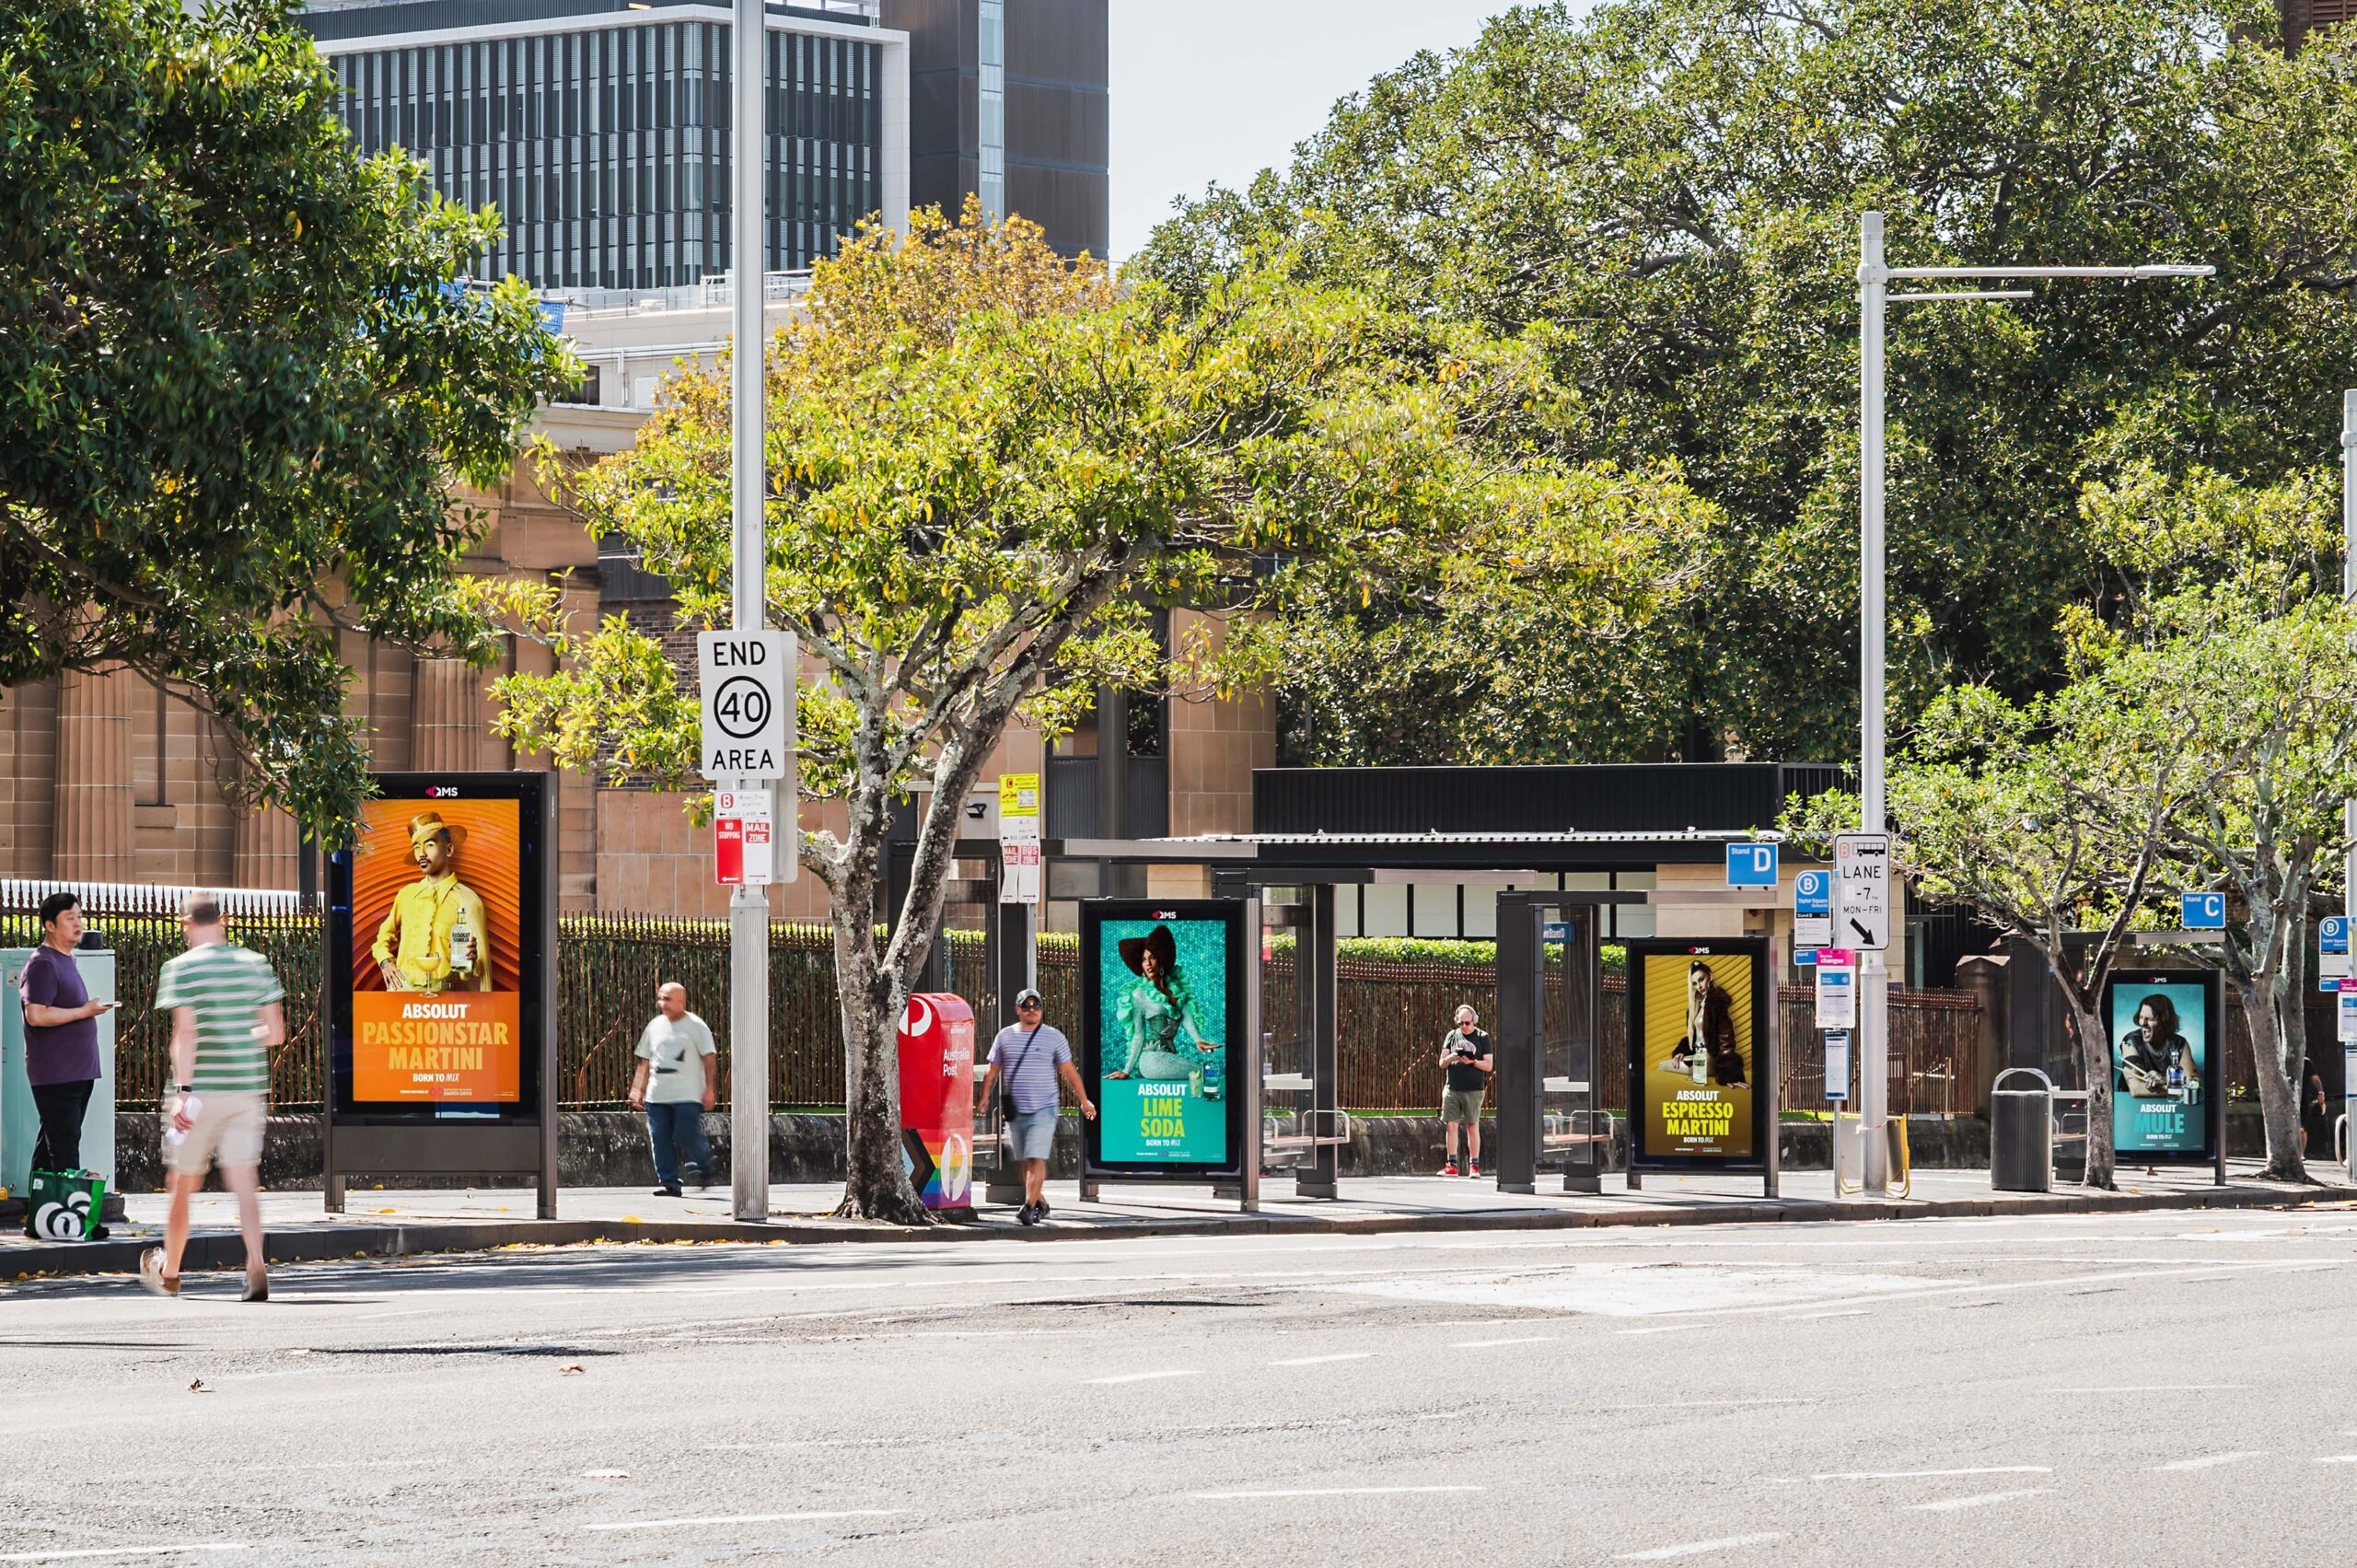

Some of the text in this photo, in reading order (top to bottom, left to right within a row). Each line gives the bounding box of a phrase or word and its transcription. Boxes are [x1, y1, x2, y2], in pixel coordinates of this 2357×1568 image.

[714, 642, 766, 666] END
[720, 691, 764, 723] 40
[712, 749, 774, 770] AREA
[721, 794, 734, 808] B
[746, 823, 768, 832] MAIL
[749, 833, 766, 842] ZONE
[1754, 848, 1771, 872] D
[1843, 865, 1881, 878] LANE
[1804, 878, 1812, 890] B
[2204, 896, 2219, 917] C
[402, 1004, 468, 1019] ABSOLUT
[363, 1022, 508, 1045] PASSIONSTAR
[389, 1047, 482, 1070] MARTINI
[944, 1048, 970, 1062] Australia
[944, 1063, 958, 1076] Post
[412, 1074, 434, 1082] BORN
[435, 1074, 445, 1082] TO
[1138, 1084, 1187, 1096] ABSOLUT
[1677, 1090, 1719, 1100] ABSOLUT
[1144, 1098, 1182, 1116] LIME
[1663, 1102, 1734, 1119] ESPRESSO
[2141, 1104, 2177, 1112] ABSOLUT
[1141, 1118, 1185, 1137] SODA
[1666, 1120, 1729, 1135] MARTINI
[2135, 1114, 2185, 1133] MULE
